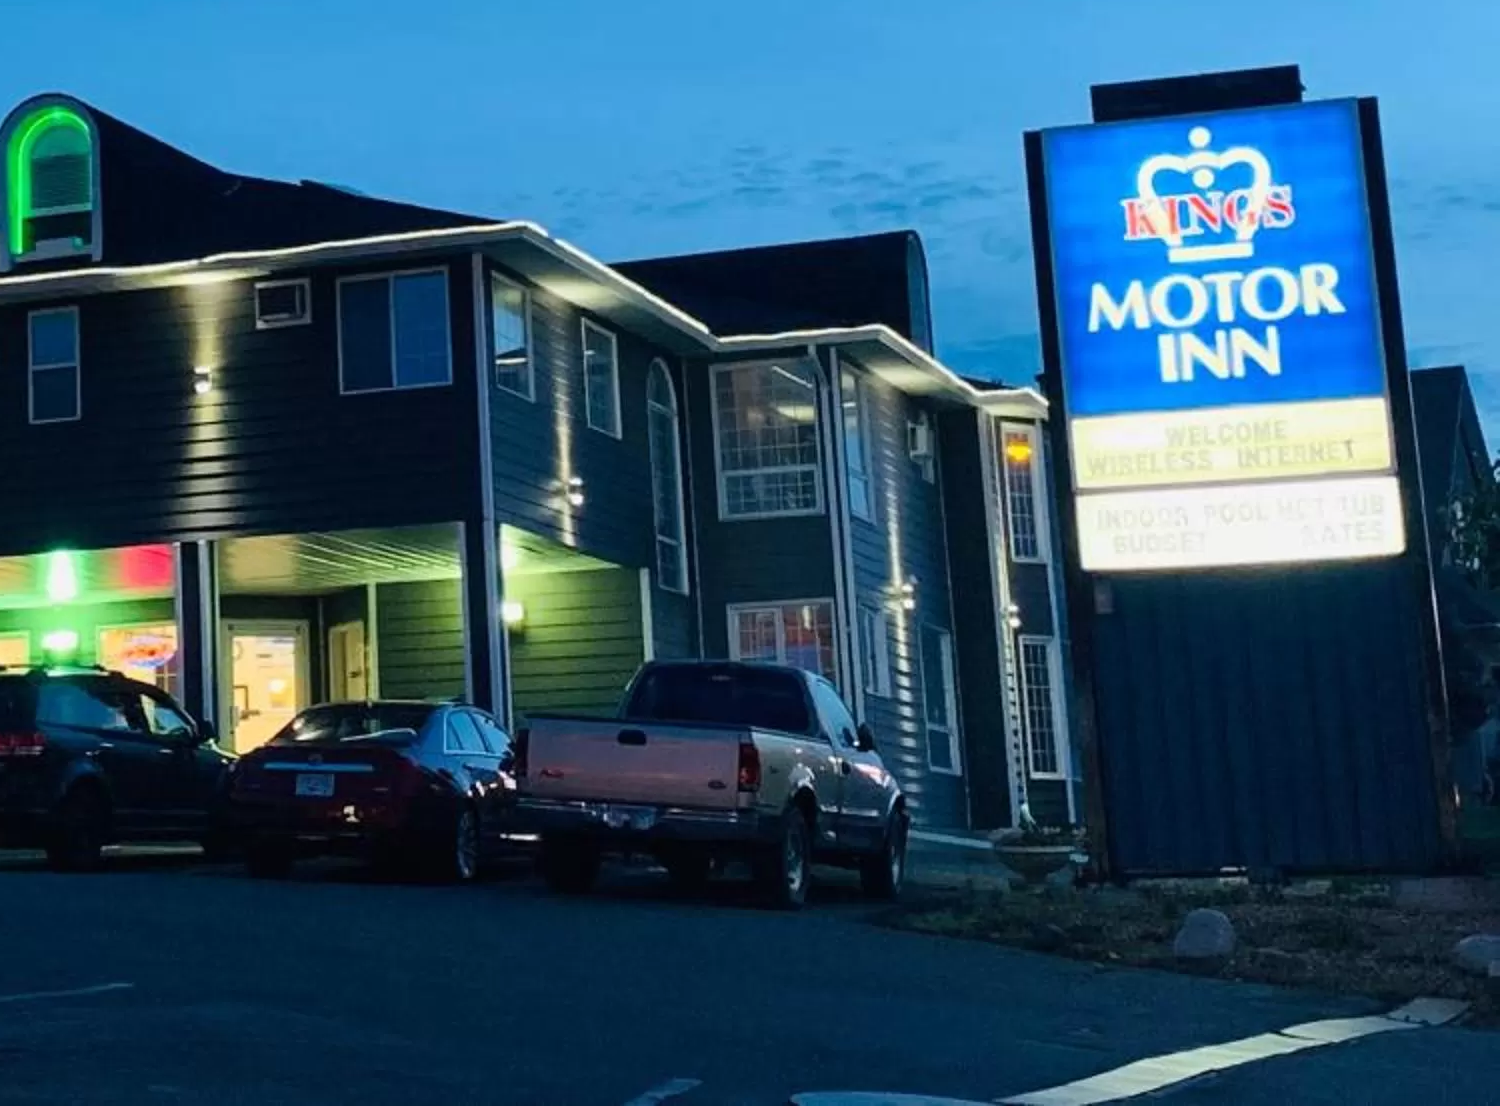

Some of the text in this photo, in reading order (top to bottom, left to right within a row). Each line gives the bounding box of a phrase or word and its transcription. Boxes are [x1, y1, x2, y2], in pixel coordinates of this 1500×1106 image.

[1121, 185, 1296, 240] KINGS
[1088, 263, 1346, 332] MOTOR
[1157, 325, 1281, 382] INN
[1165, 419, 1288, 448] WELCOME
[1087, 438, 1356, 477] WIRELESS INTERNET
[1097, 505, 1189, 530] INDOOR
[1204, 502, 1269, 526] POOL
[1336, 493, 1385, 517] TUB
